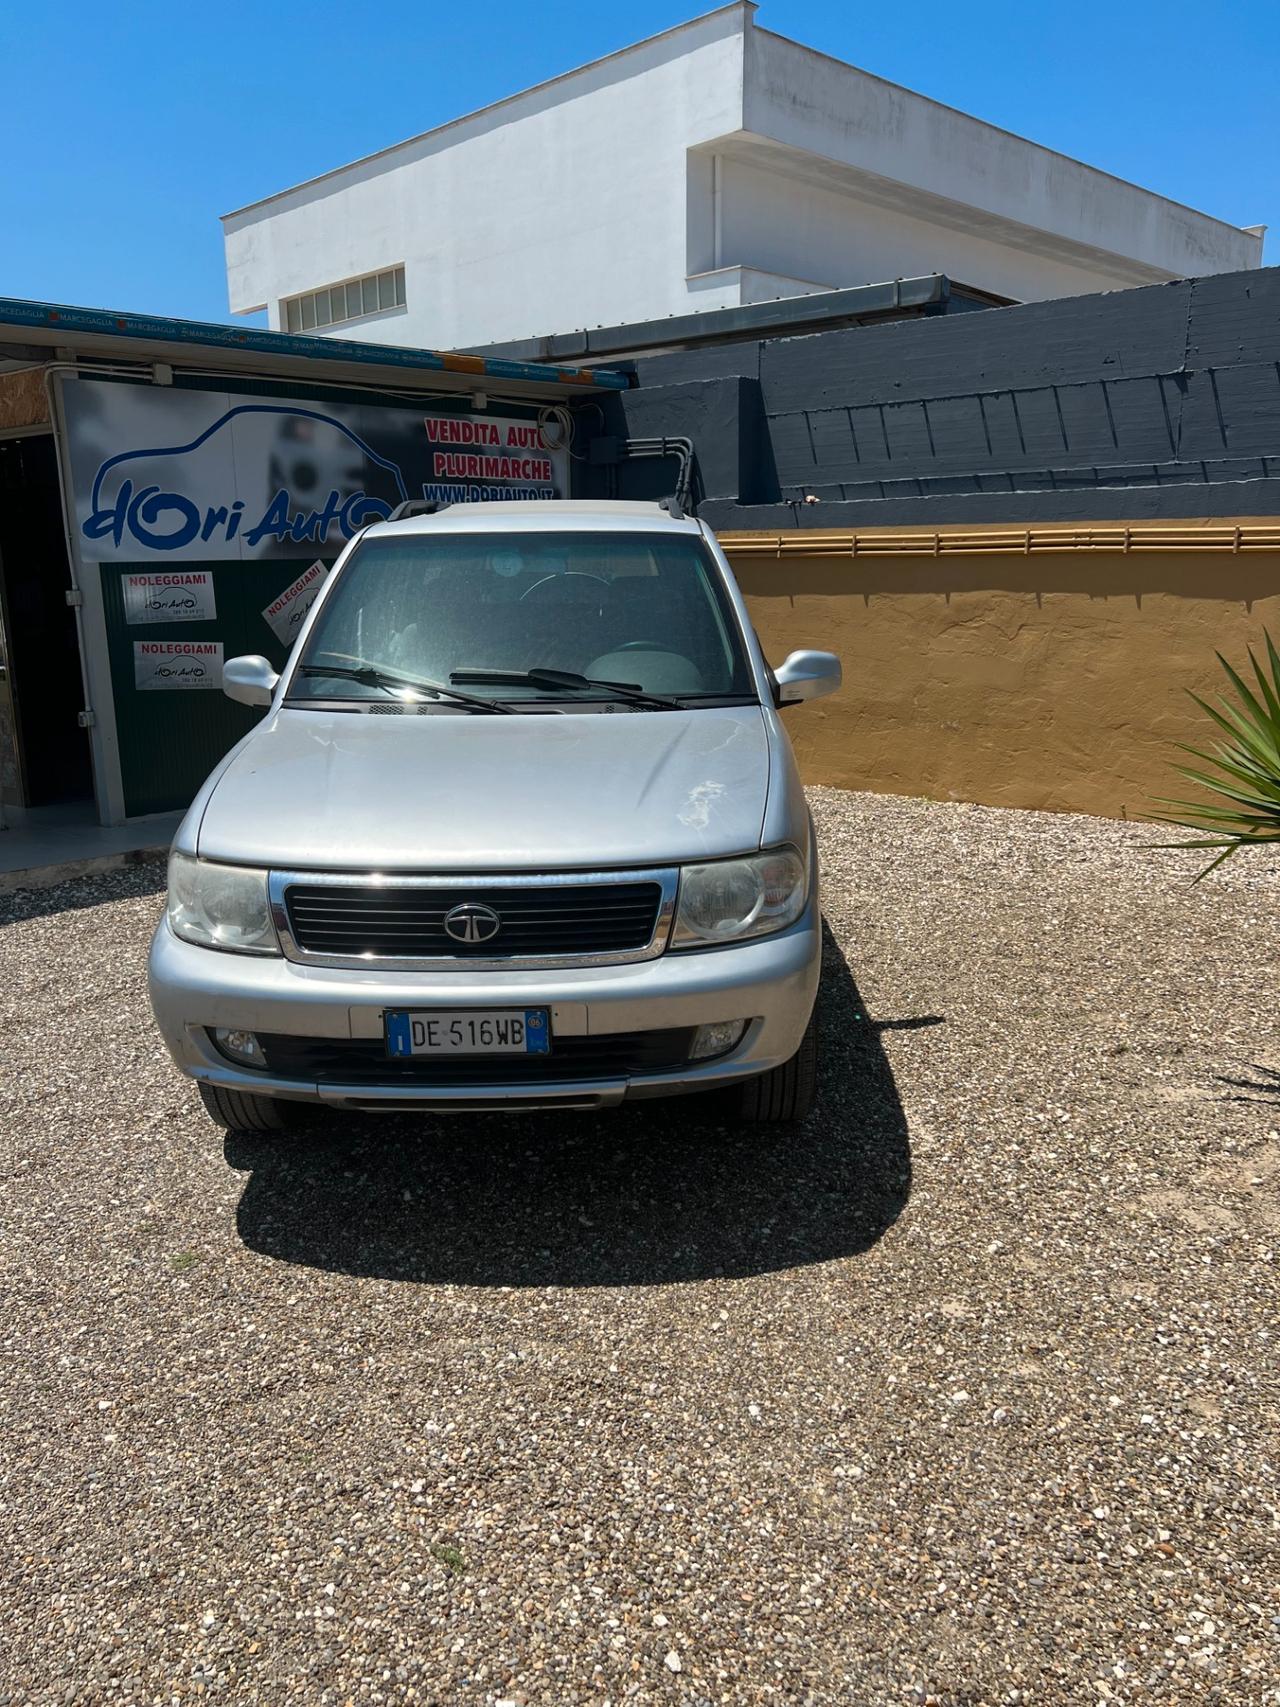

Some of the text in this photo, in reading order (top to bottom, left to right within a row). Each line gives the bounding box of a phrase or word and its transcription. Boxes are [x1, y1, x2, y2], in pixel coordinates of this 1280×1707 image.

[59, 313, 113, 327] MARCEGAGLIA
[425, 418, 500, 445] VENDITA
[434, 452, 552, 480] PLURIMARCHE
[129, 574, 207, 587] NOLEGGIAMI
[267, 564, 321, 617] NOLEGGIAMI
[141, 644, 217, 655] NOLEGGIAMI
[412, 1020, 441, 1047] DE
[449, 1019, 524, 1047] 516WB
